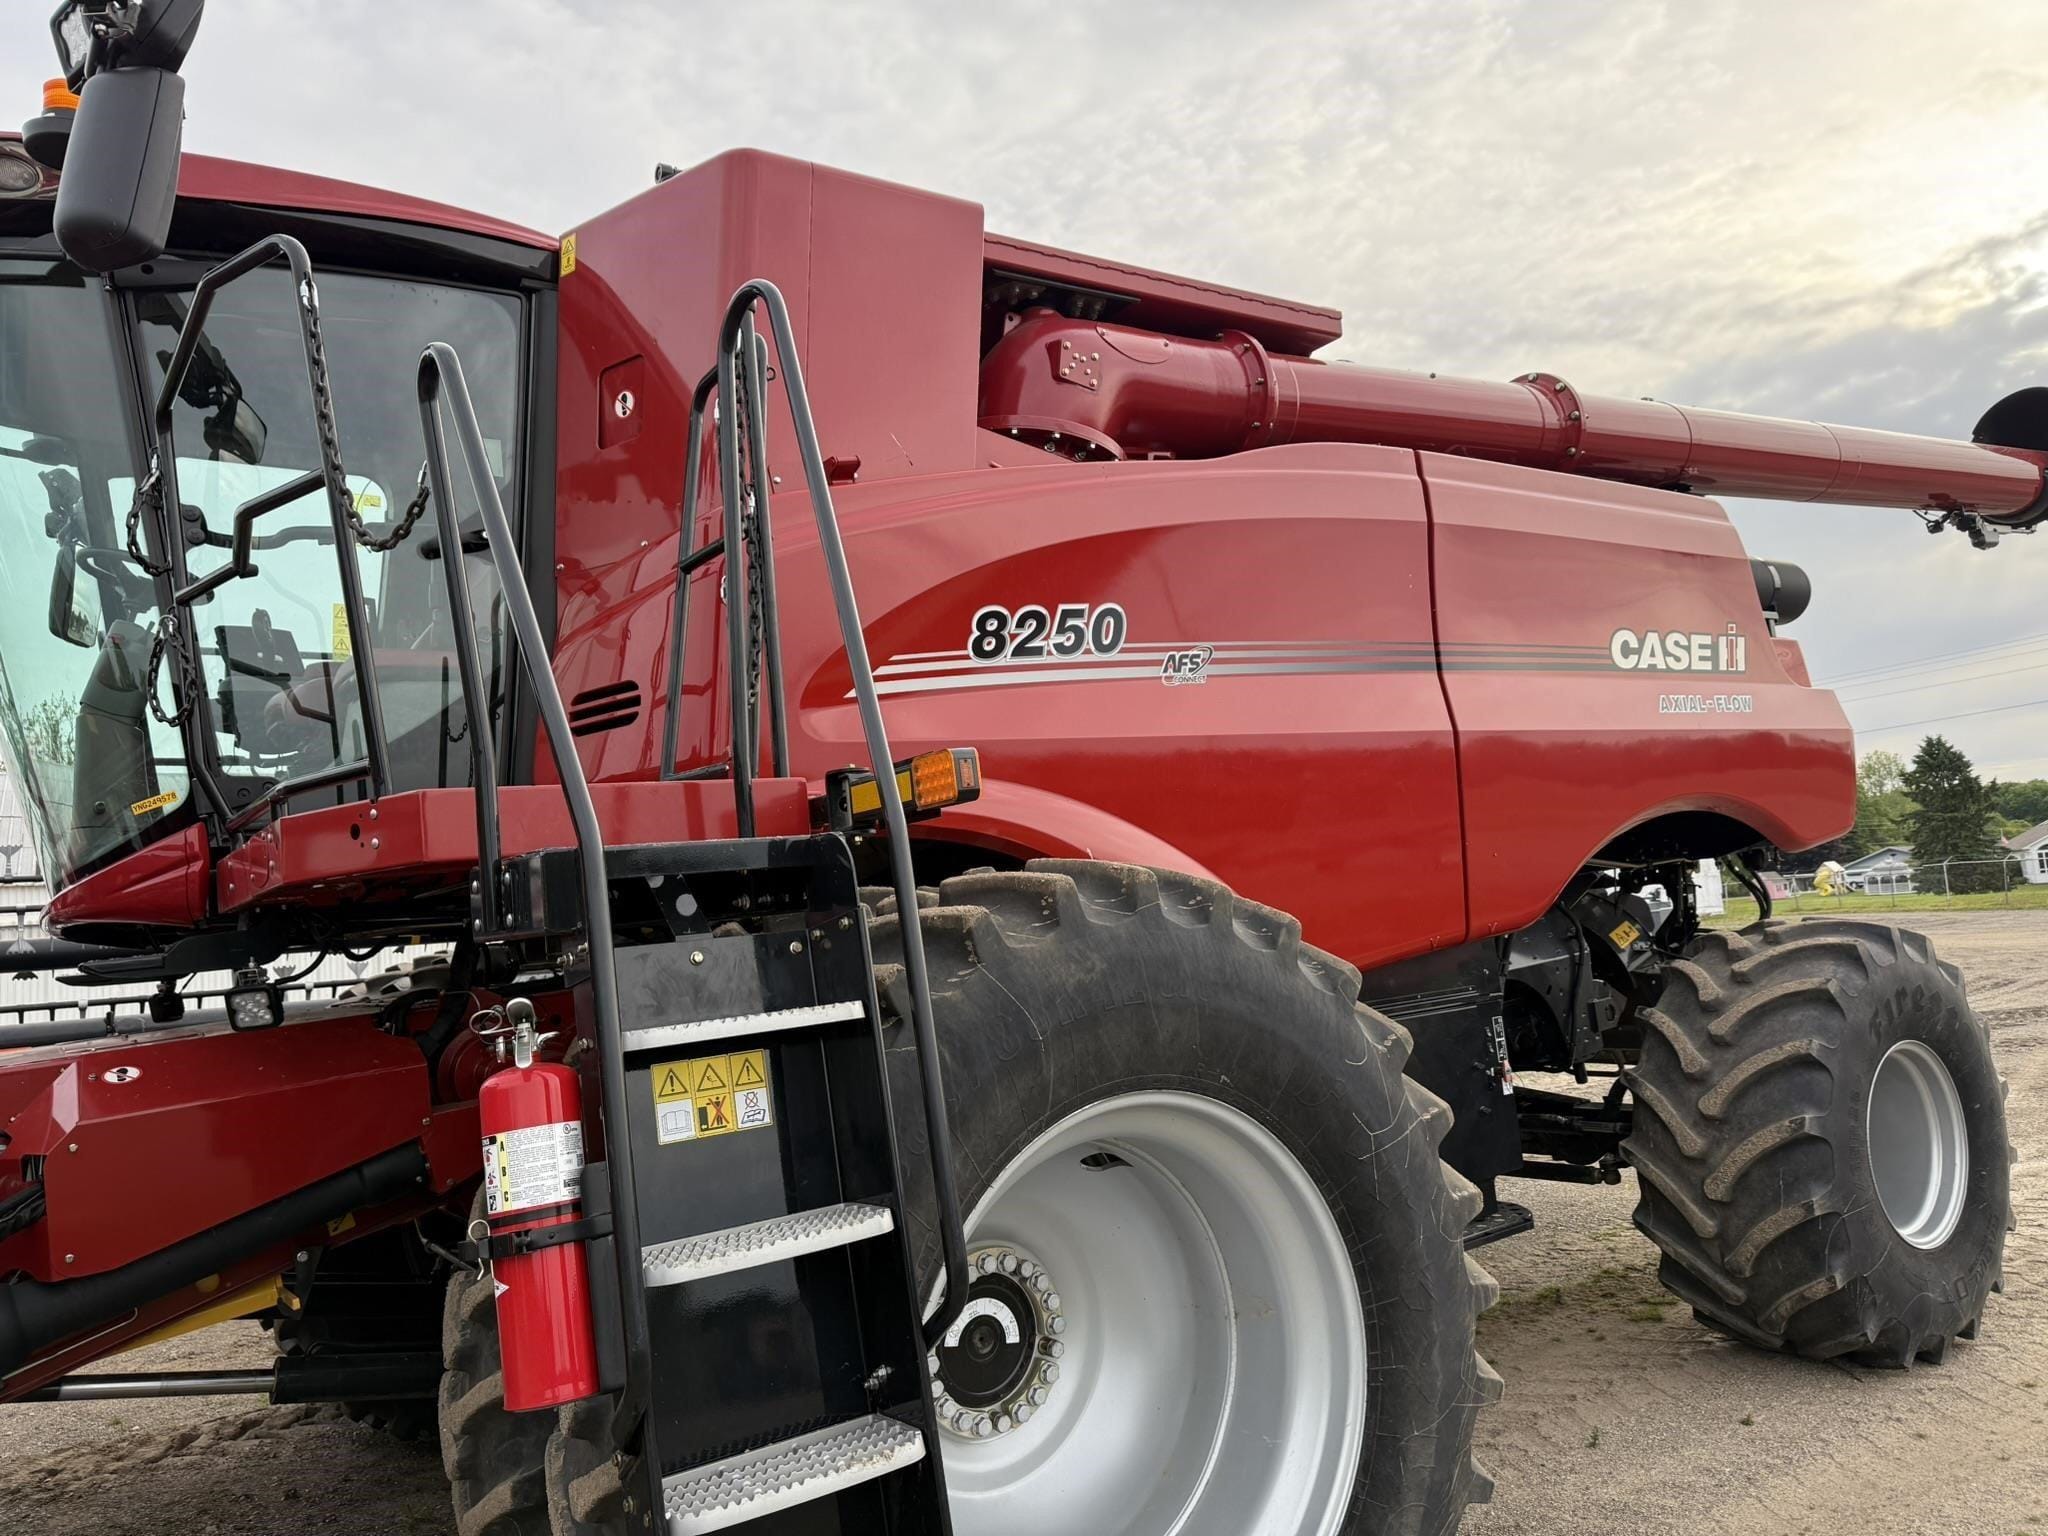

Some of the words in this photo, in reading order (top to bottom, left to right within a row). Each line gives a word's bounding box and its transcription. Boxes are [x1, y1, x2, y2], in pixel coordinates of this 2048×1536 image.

[968, 603, 1126, 662] 8250
[1610, 629, 1713, 671] CASE
[1162, 653, 1204, 675] AFS
[1173, 674, 1206, 684] CONNECT
[1659, 694, 1753, 713] AXIAL-FLOW
[499, 1140, 505, 1152] A
[501, 1166, 507, 1177] B
[503, 1191, 509, 1202] C
